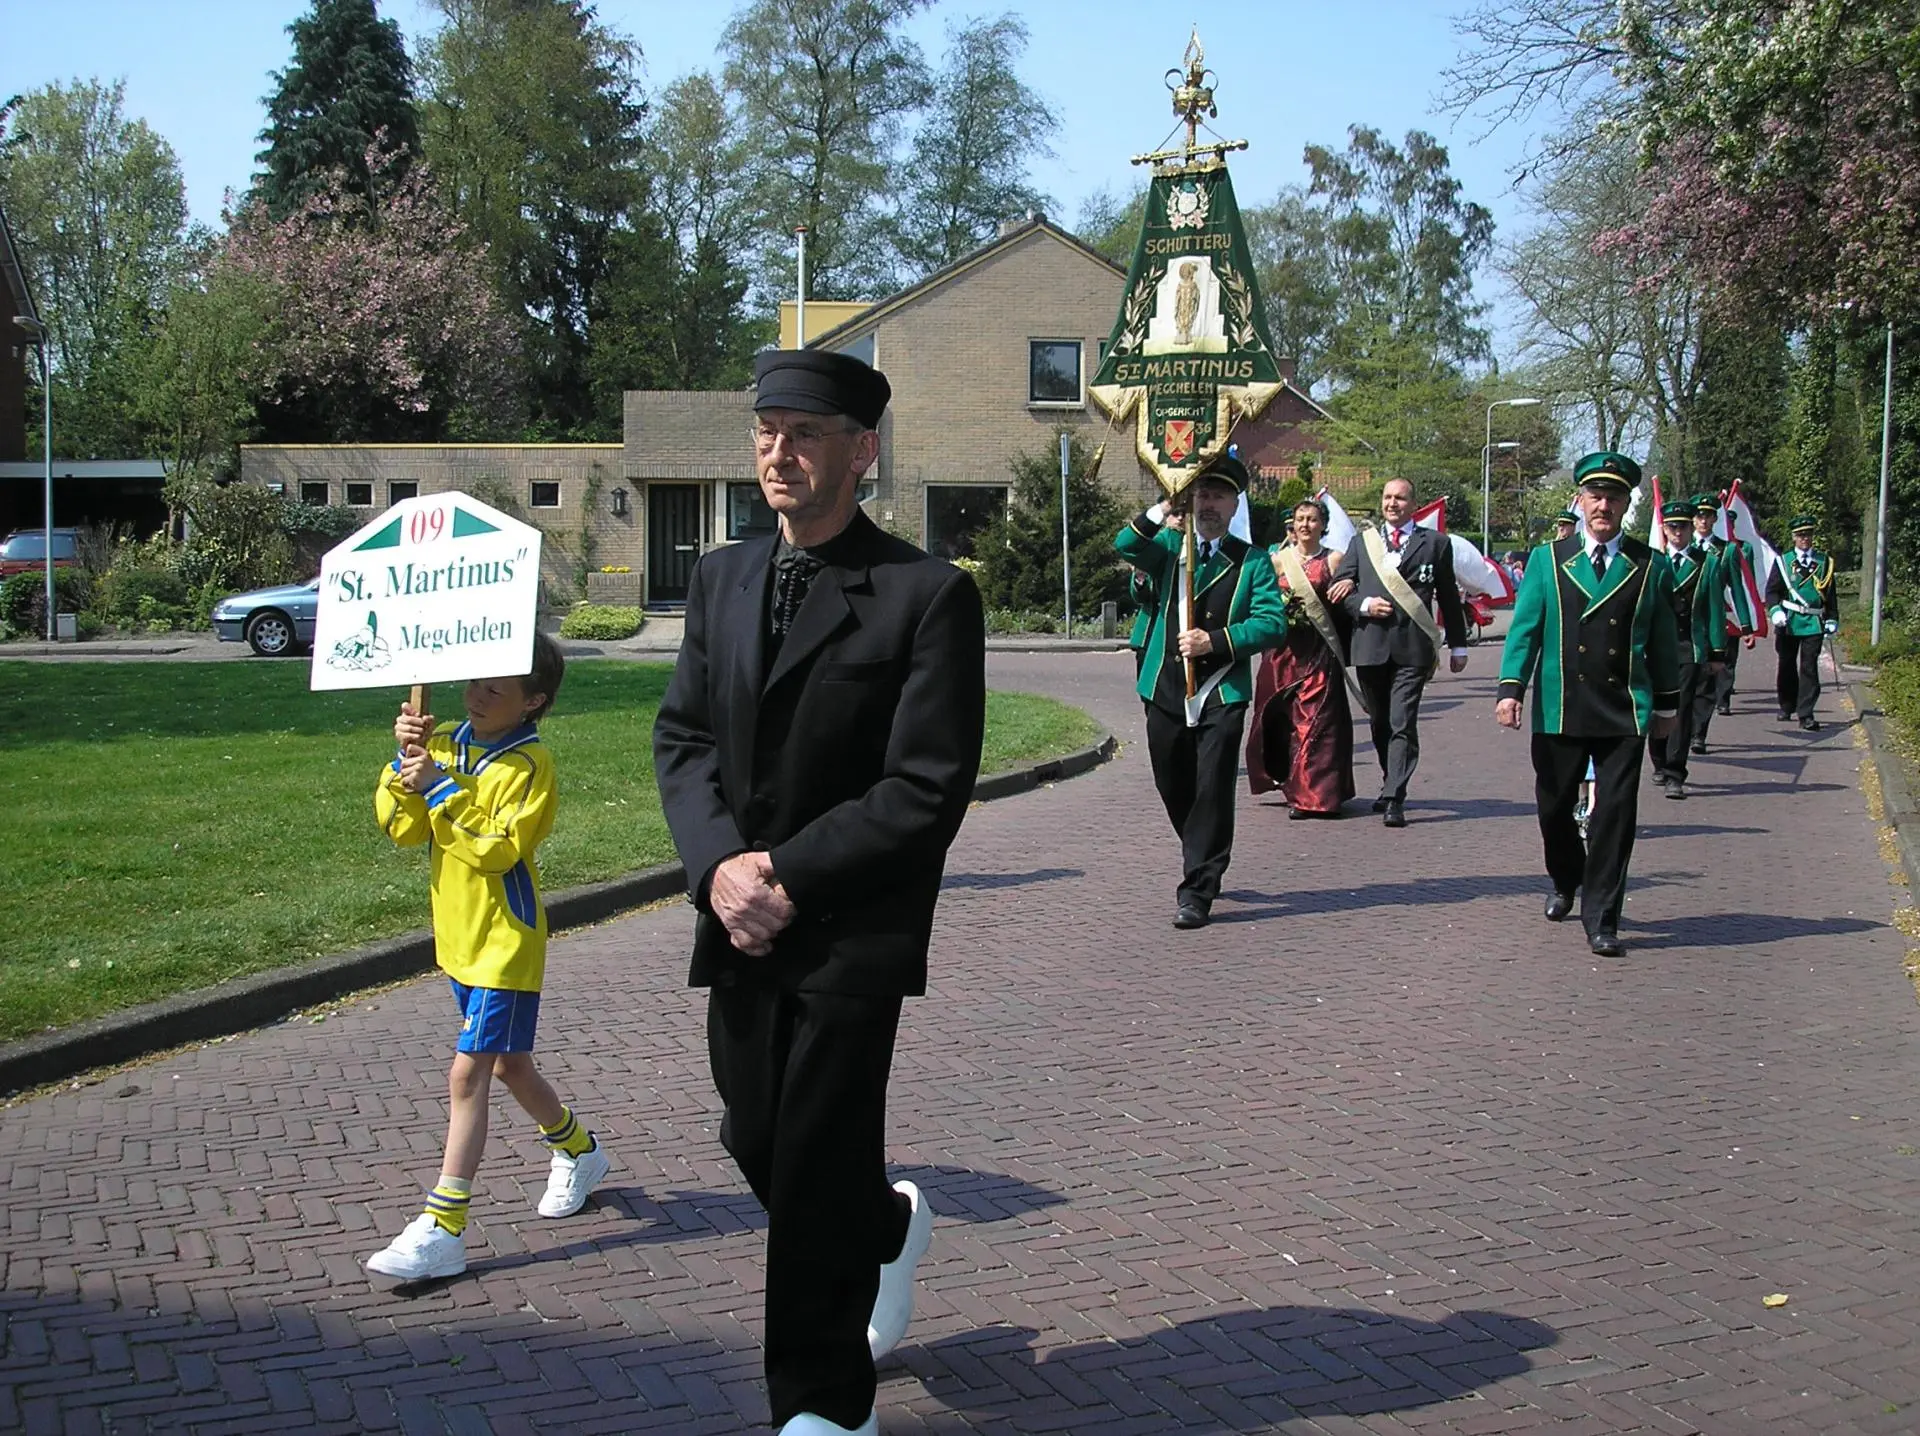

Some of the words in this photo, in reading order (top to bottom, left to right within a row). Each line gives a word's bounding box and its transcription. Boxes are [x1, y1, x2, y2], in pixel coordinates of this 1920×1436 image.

[1143, 359, 1254, 380] MARTINUS
[1155, 406, 1206, 417] OPGERICHT
[410, 507, 445, 545] 09
[398, 616, 513, 655] Megchelen
